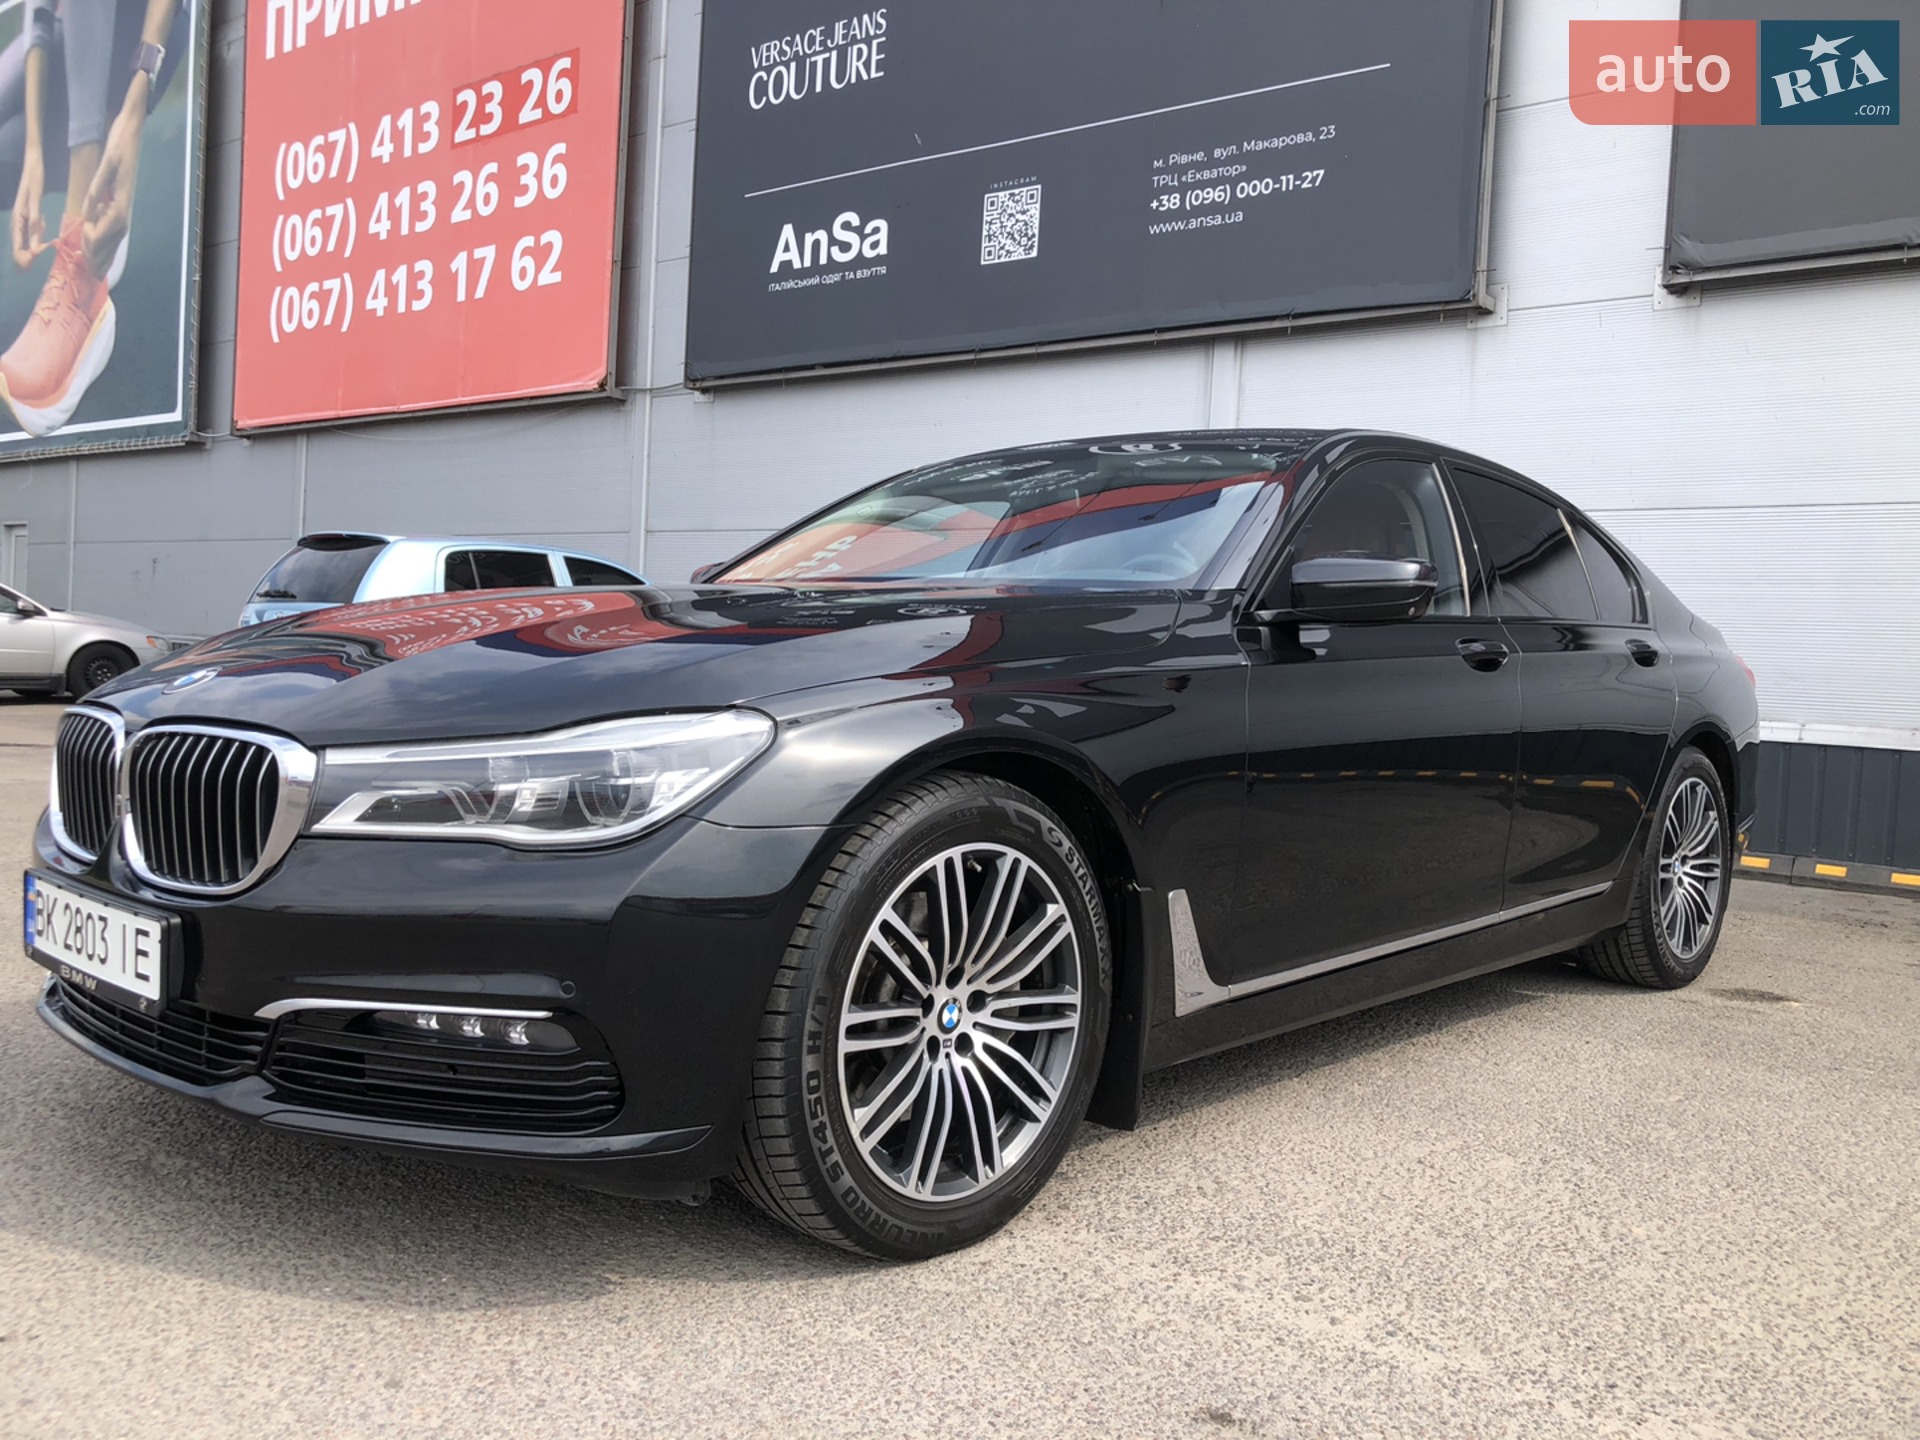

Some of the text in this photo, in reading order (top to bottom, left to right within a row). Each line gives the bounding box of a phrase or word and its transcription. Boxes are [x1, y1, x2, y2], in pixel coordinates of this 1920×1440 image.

[751, 8, 887, 69] VERSACE JEANS
[748, 36, 886, 110] COUTURE
[275, 57, 572, 200] (067) 413 23 26
[1152, 125, 1336, 169] м. Рівне, вул. Макарова, 23
[272, 142, 567, 272] (067) 413 26 36
[1150, 169, 1325, 212] +38 (096) 000-11-27
[1152, 164, 1247, 188] ТРЦ «Екватор»
[769, 211, 889, 274] AnSa
[1149, 211, 1244, 235] www.ansa.ua
[270, 229, 563, 343] (067) 413 17 62
[768, 266, 887, 292] ІТАЛІЙСЬКИЙ ОДЯГ ТА ВЗУТТЯ
[36, 888, 151, 983] BK 2803 IE
[60, 964, 98, 991] BMW
[806, 1069, 845, 1184] ST450
